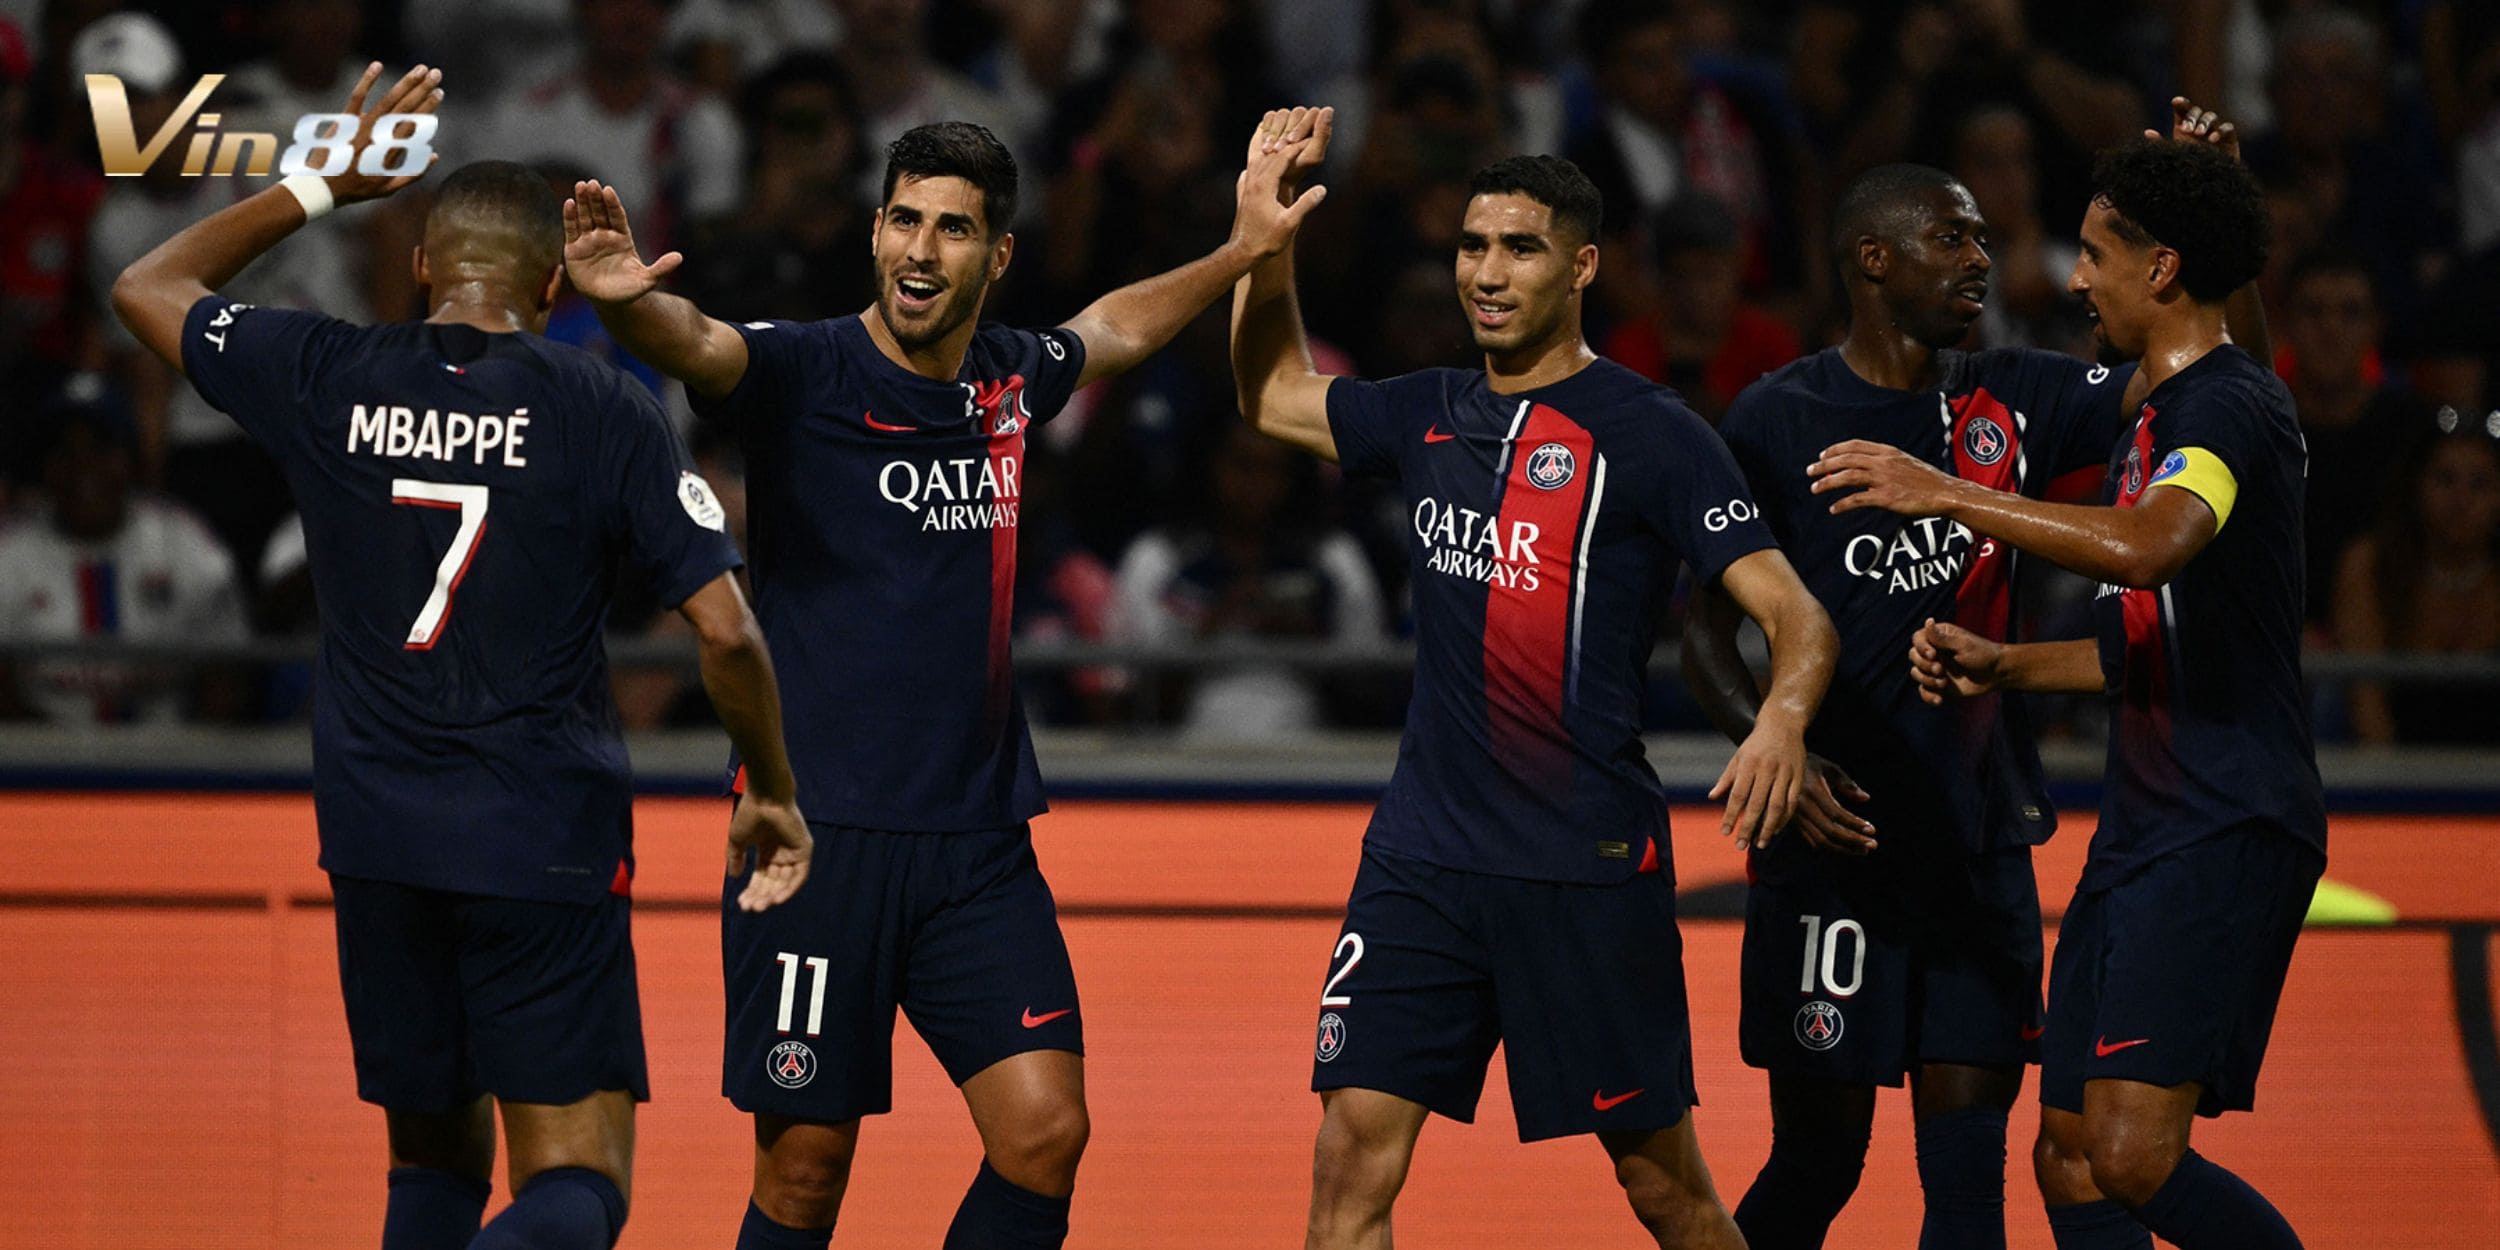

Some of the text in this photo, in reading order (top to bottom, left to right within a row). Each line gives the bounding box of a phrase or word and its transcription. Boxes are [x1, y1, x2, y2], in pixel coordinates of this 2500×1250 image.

[348, 404, 530, 467] MBAPPÉ
[878, 456, 1019, 513] QATAR
[922, 502, 1017, 532] AIRWAYS
[1415, 497, 1540, 564] QATAR
[1844, 517, 1975, 580] QATA
[391, 478, 489, 650] 7
[1427, 546, 1540, 592] AIRWAYS
[1321, 932, 1364, 1008] 2
[1799, 914, 1866, 998] 10
[776, 951, 829, 1038] 11
[1803, 1003, 1836, 1017] PARIS
[776, 1043, 809, 1057] PARIS
